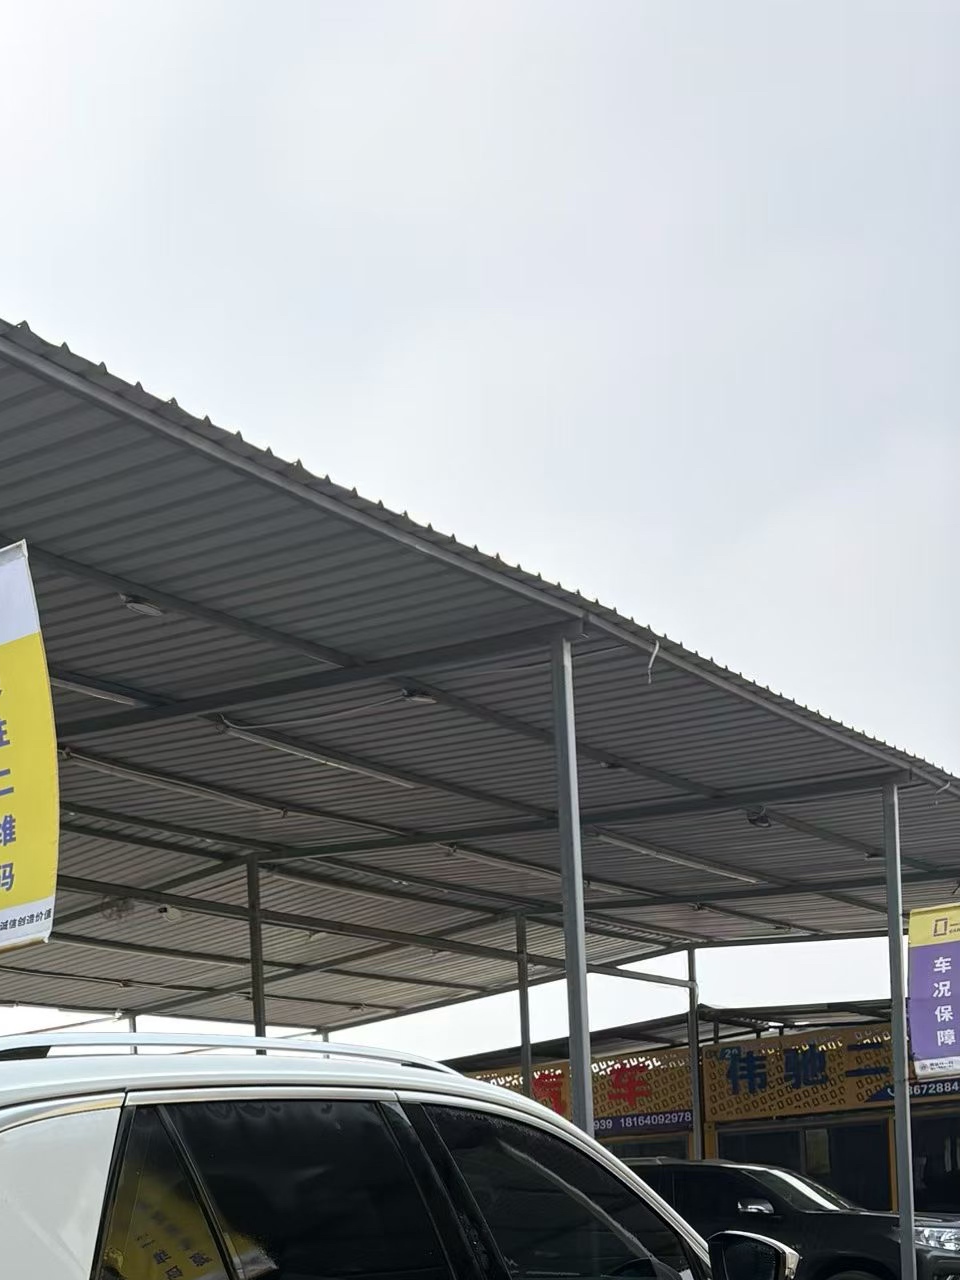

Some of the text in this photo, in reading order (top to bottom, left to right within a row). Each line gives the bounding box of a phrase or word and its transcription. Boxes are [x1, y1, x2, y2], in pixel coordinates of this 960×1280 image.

[0, 908, 52, 931] 诚信创造价值
[933, 956, 957, 1047] 车况保障
[619, 1112, 692, 1128] 18164092978
